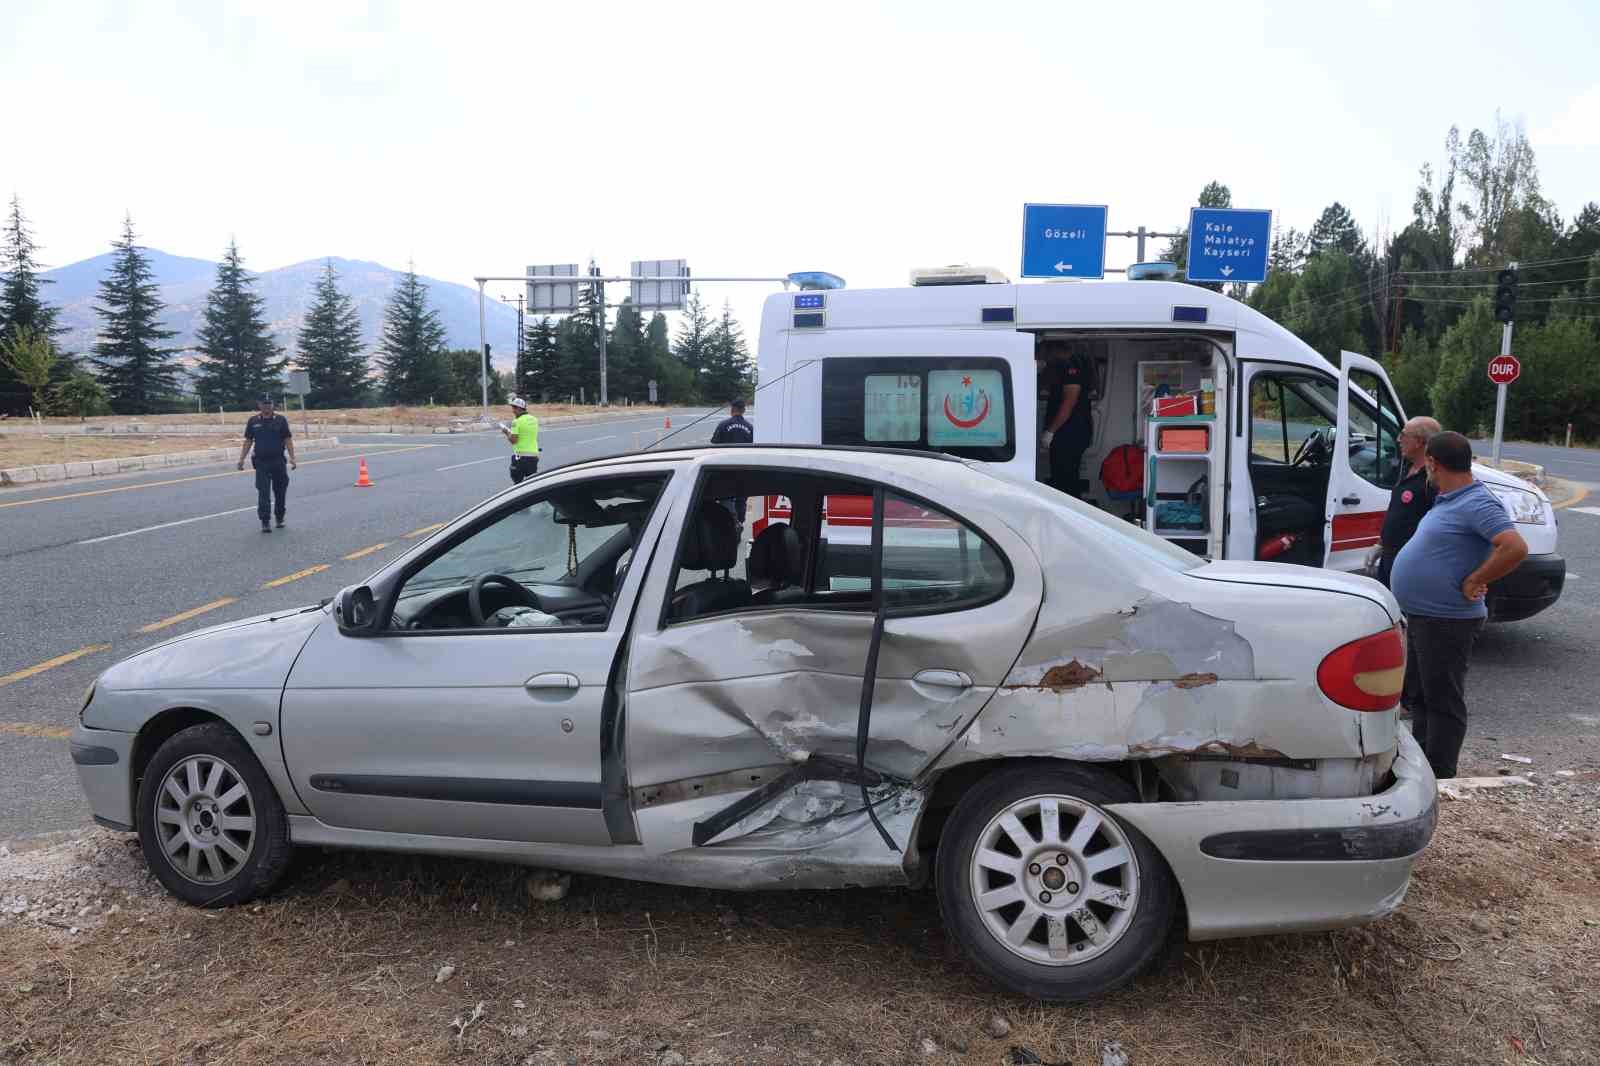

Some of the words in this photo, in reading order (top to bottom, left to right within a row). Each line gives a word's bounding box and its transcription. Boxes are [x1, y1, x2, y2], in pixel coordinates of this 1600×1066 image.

[1205, 222, 1233, 233] Kale
[1044, 228, 1086, 239] Gözeli
[1204, 234, 1255, 247] Malatya
[1204, 247, 1250, 258] Kayseri
[1492, 363, 1514, 375] DUR
